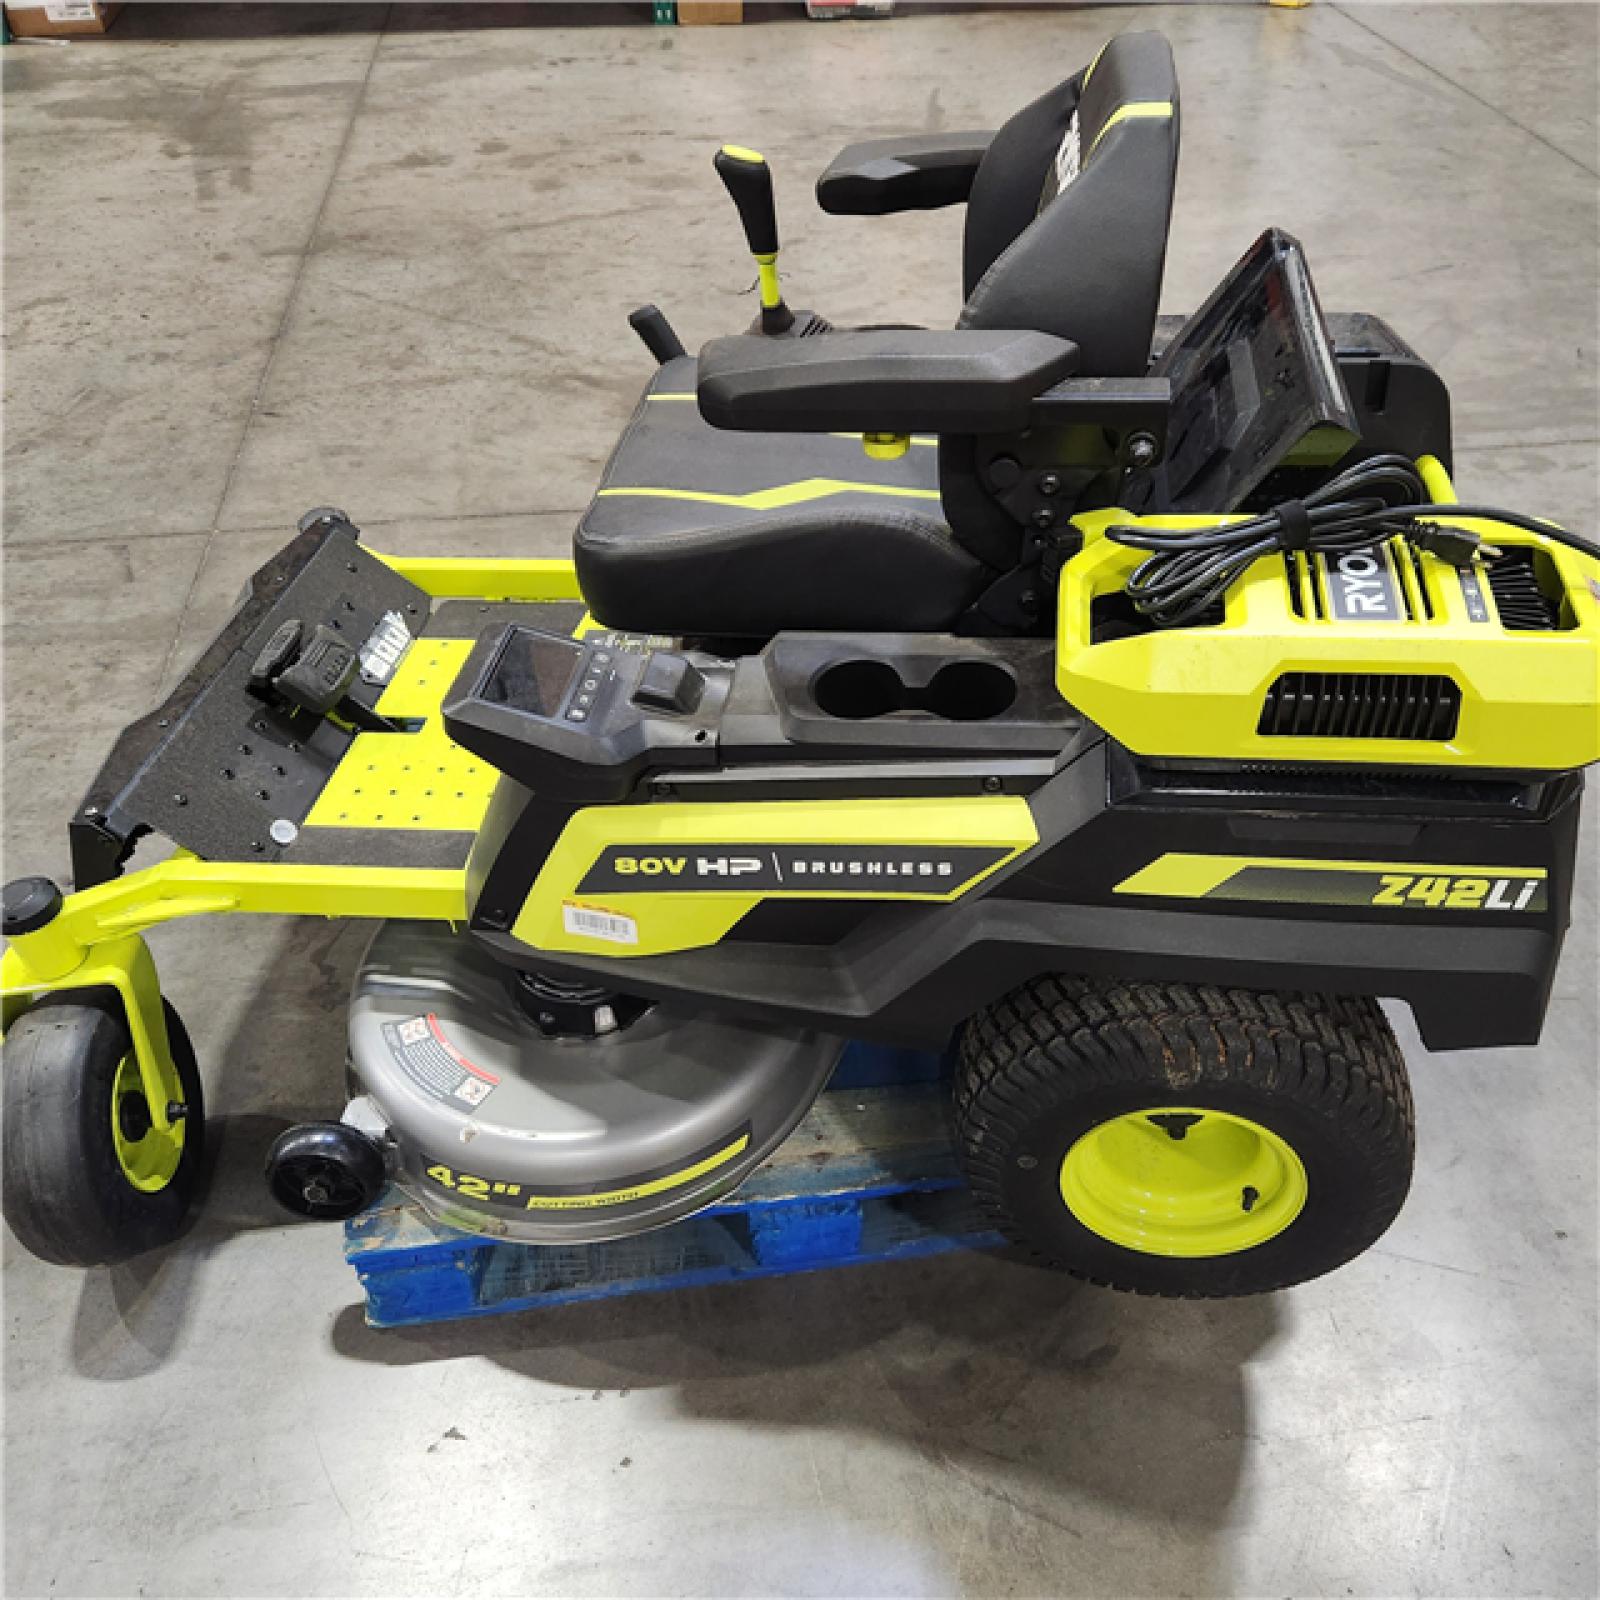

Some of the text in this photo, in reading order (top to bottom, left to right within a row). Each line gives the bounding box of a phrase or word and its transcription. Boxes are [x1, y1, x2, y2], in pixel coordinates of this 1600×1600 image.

[1337, 547, 1388, 613] RYO
[614, 857, 687, 875] 80V
[697, 857, 763, 875] HP
